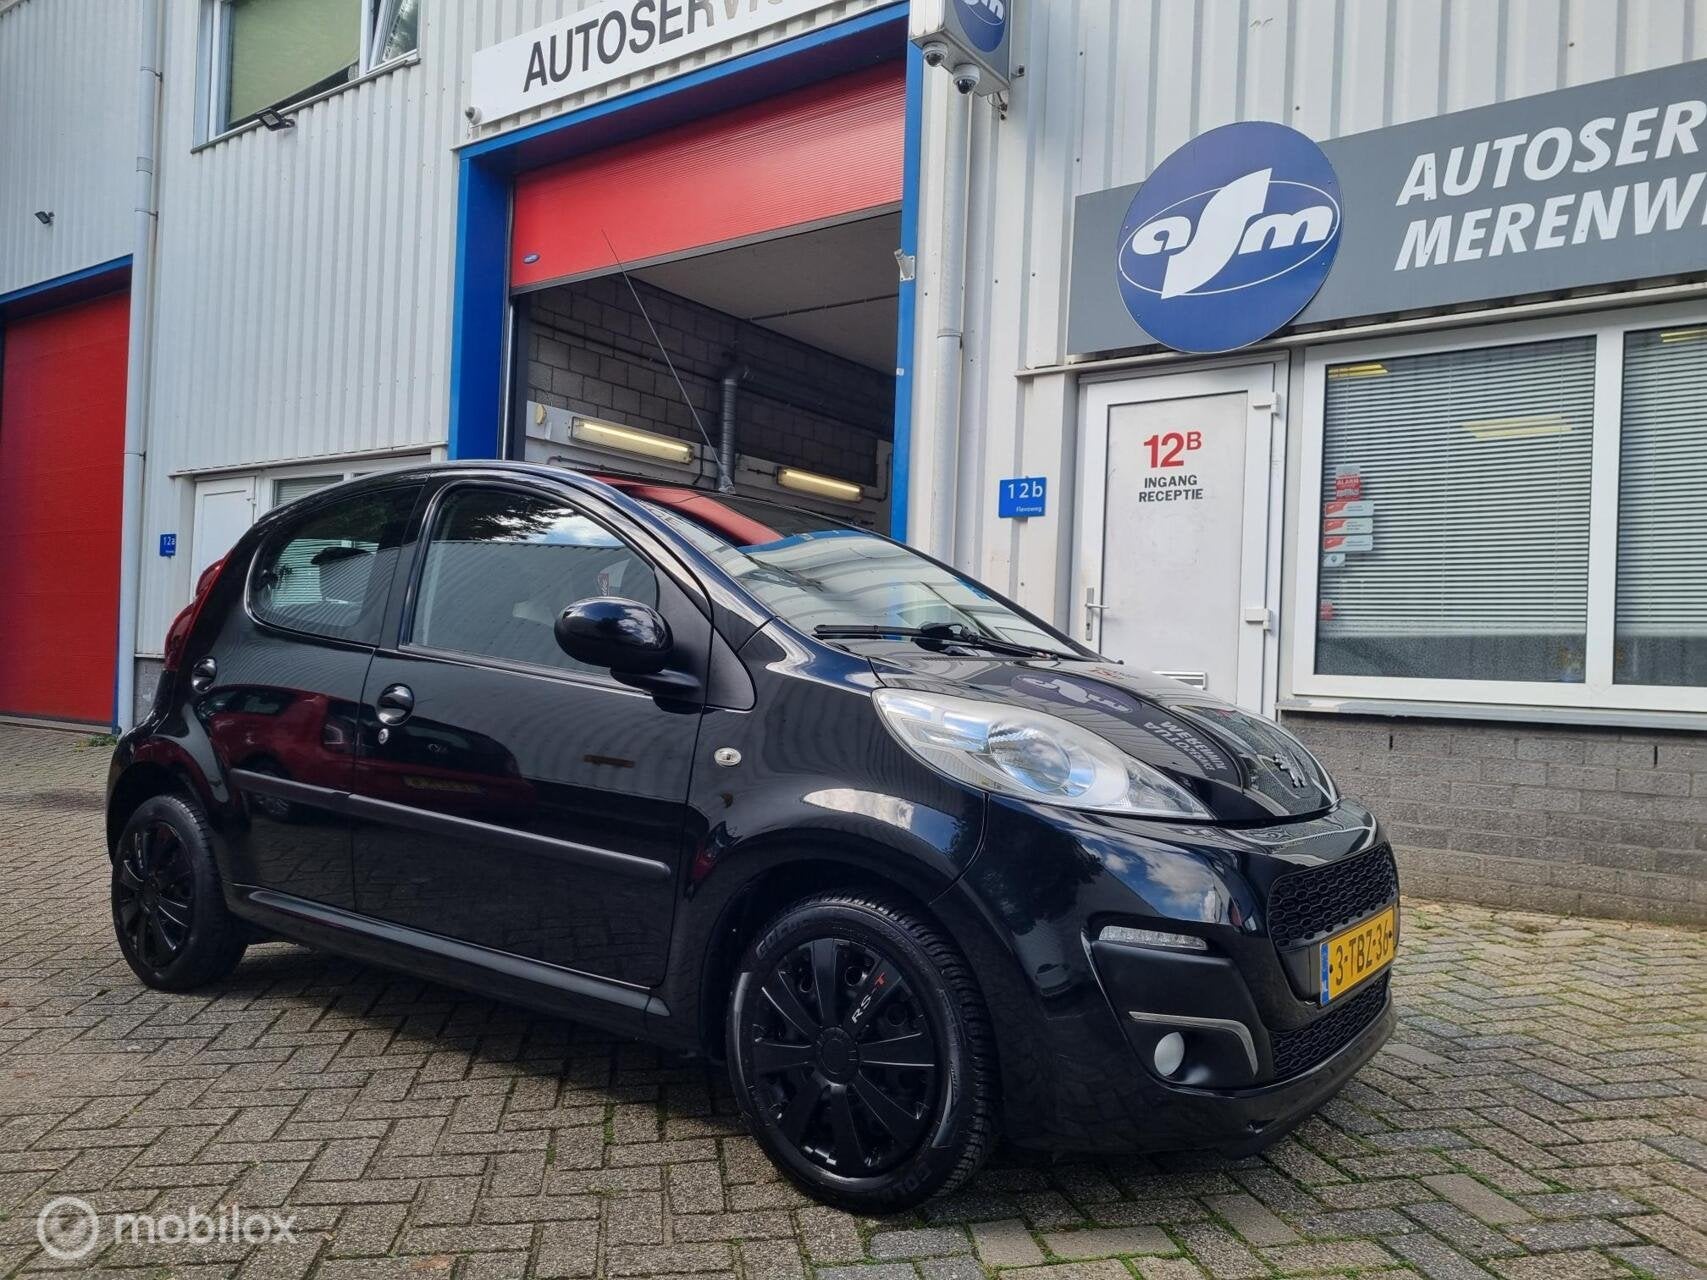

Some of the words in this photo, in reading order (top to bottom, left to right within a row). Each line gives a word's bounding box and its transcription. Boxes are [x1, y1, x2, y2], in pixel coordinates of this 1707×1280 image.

[1143, 431, 1202, 468] 12B
[1008, 481, 1043, 499] 12b
[1144, 475, 1198, 489] INGANG
[1139, 489, 1203, 502] RECEPTIE
